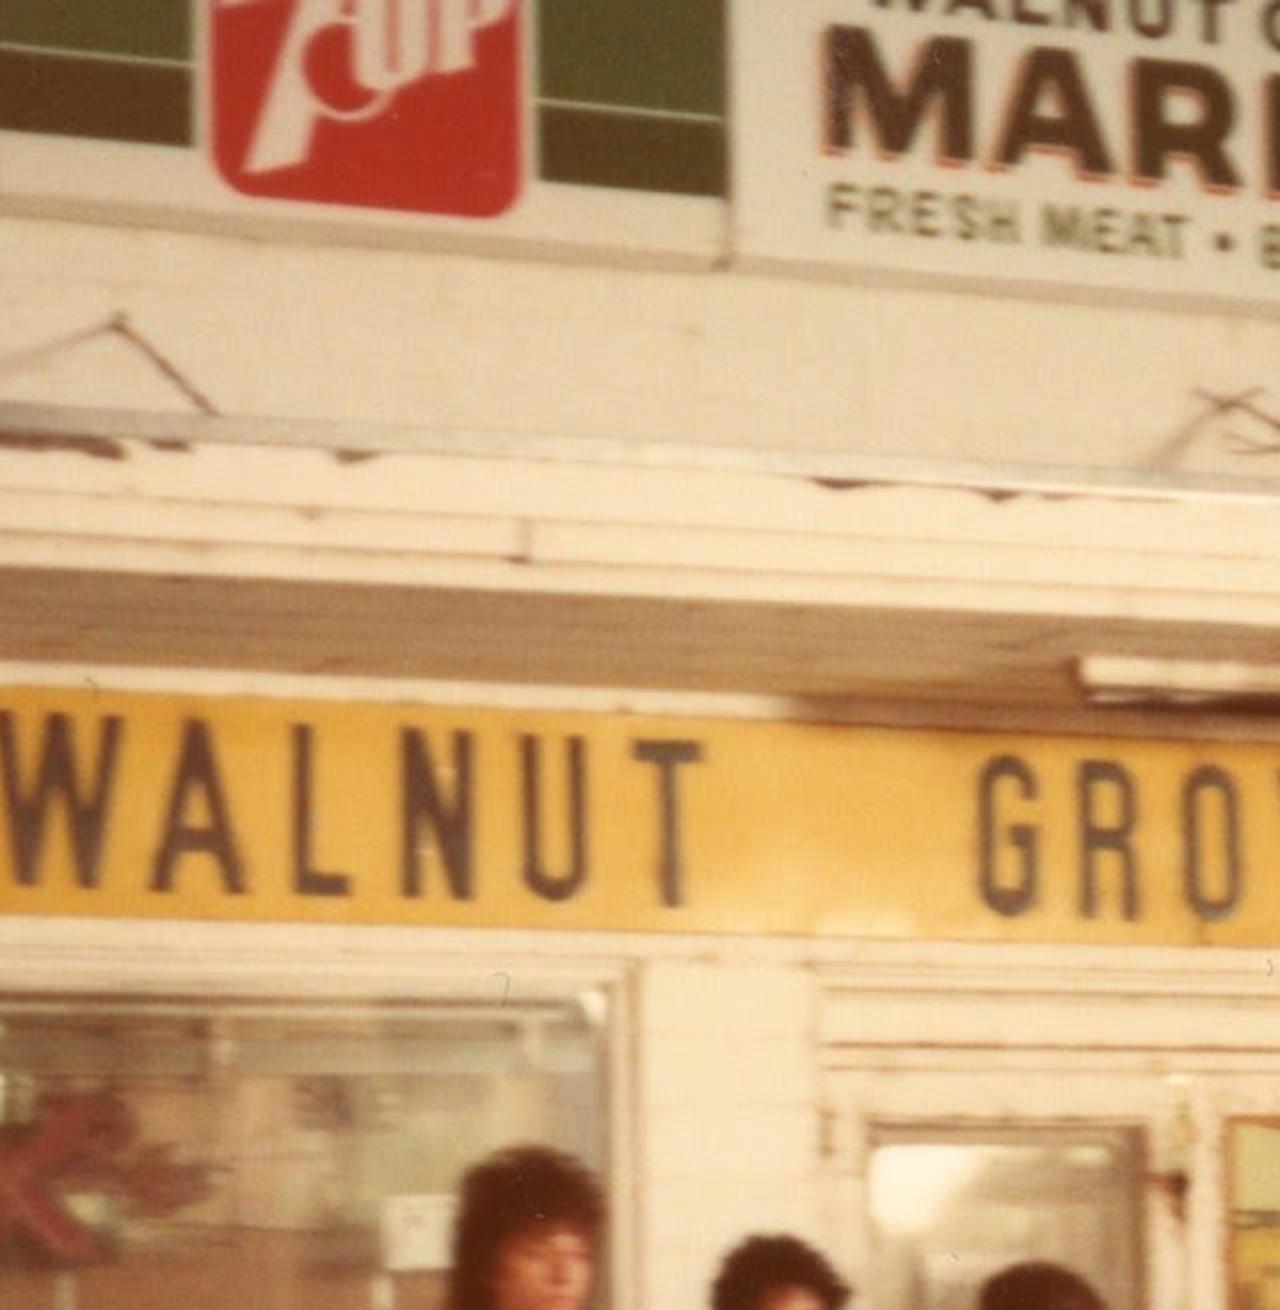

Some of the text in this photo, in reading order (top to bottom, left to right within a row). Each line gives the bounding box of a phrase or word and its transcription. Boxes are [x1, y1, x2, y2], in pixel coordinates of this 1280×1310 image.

[868, 0, 1238, 44] LNUT
[827, 182, 1022, 244] FRESH
[1040, 202, 1192, 259] MEAT
